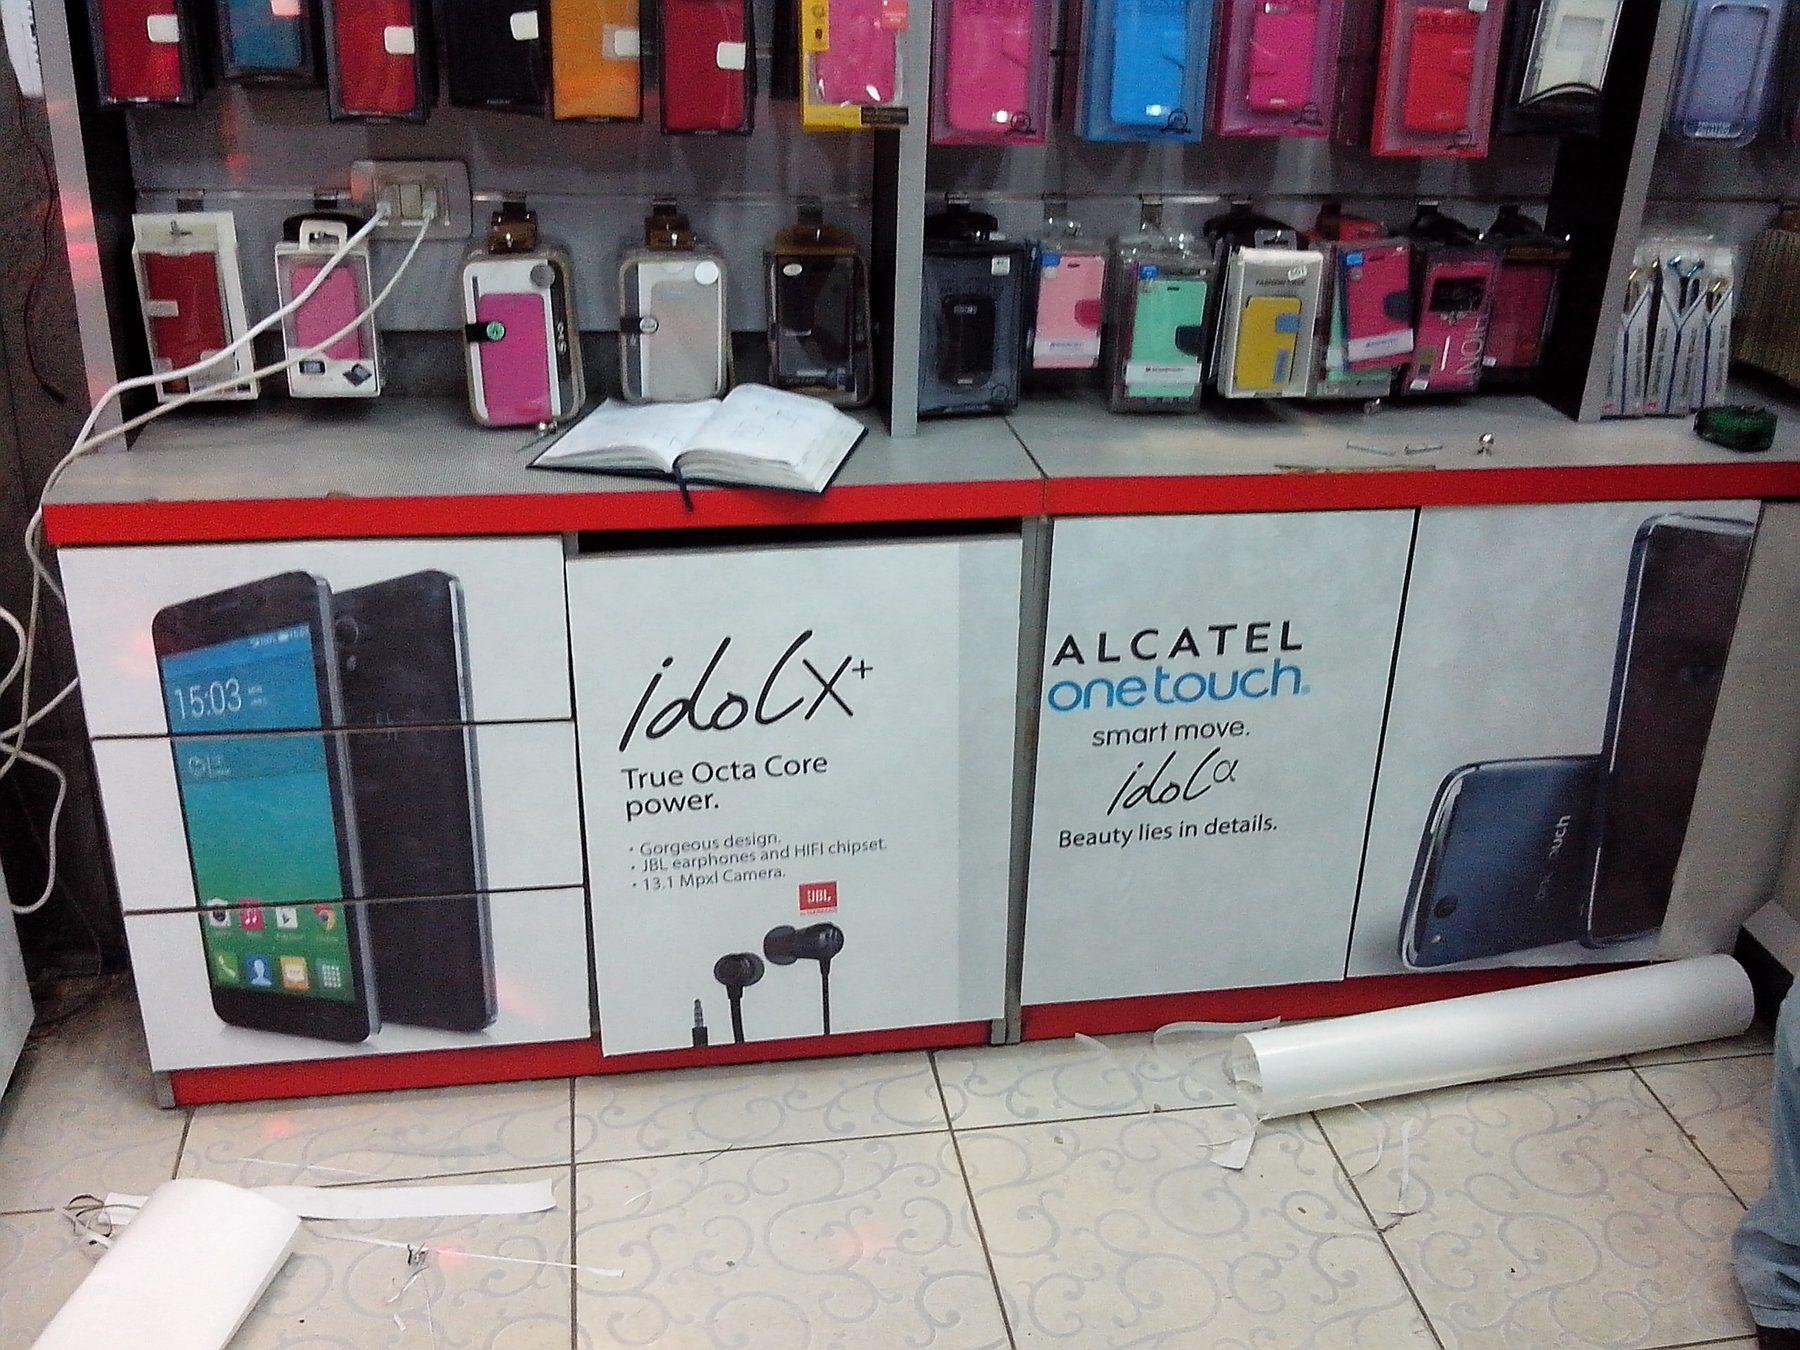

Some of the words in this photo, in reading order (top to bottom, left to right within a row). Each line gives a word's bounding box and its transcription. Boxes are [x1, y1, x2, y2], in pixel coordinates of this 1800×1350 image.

[1052, 620, 1303, 667] ALCATEL
[174, 677, 243, 720] 15:03
[1092, 722, 1168, 747] smart
[1175, 719, 1251, 741] move.
[621, 767, 683, 790] True
[692, 761, 756, 783] Octa
[765, 754, 828, 778] Core
[626, 792, 719, 822] power.
[640, 838, 720, 857] Gorgeous
[724, 831, 783, 849] design.
[1058, 828, 1133, 849] Beauty
[1138, 823, 1172, 841] lies
[1179, 820, 1198, 838] in
[1204, 813, 1277, 835] details.
[642, 856, 668, 873] JBL
[672, 851, 757, 871] earphones
[760, 845, 790, 861] and
[794, 841, 824, 858] HIFI
[828, 837, 887, 855] chipset.
[643, 875, 673, 891] 13.1
[680, 871, 718, 889] Mpxl
[721, 865, 786, 882] Camera.
